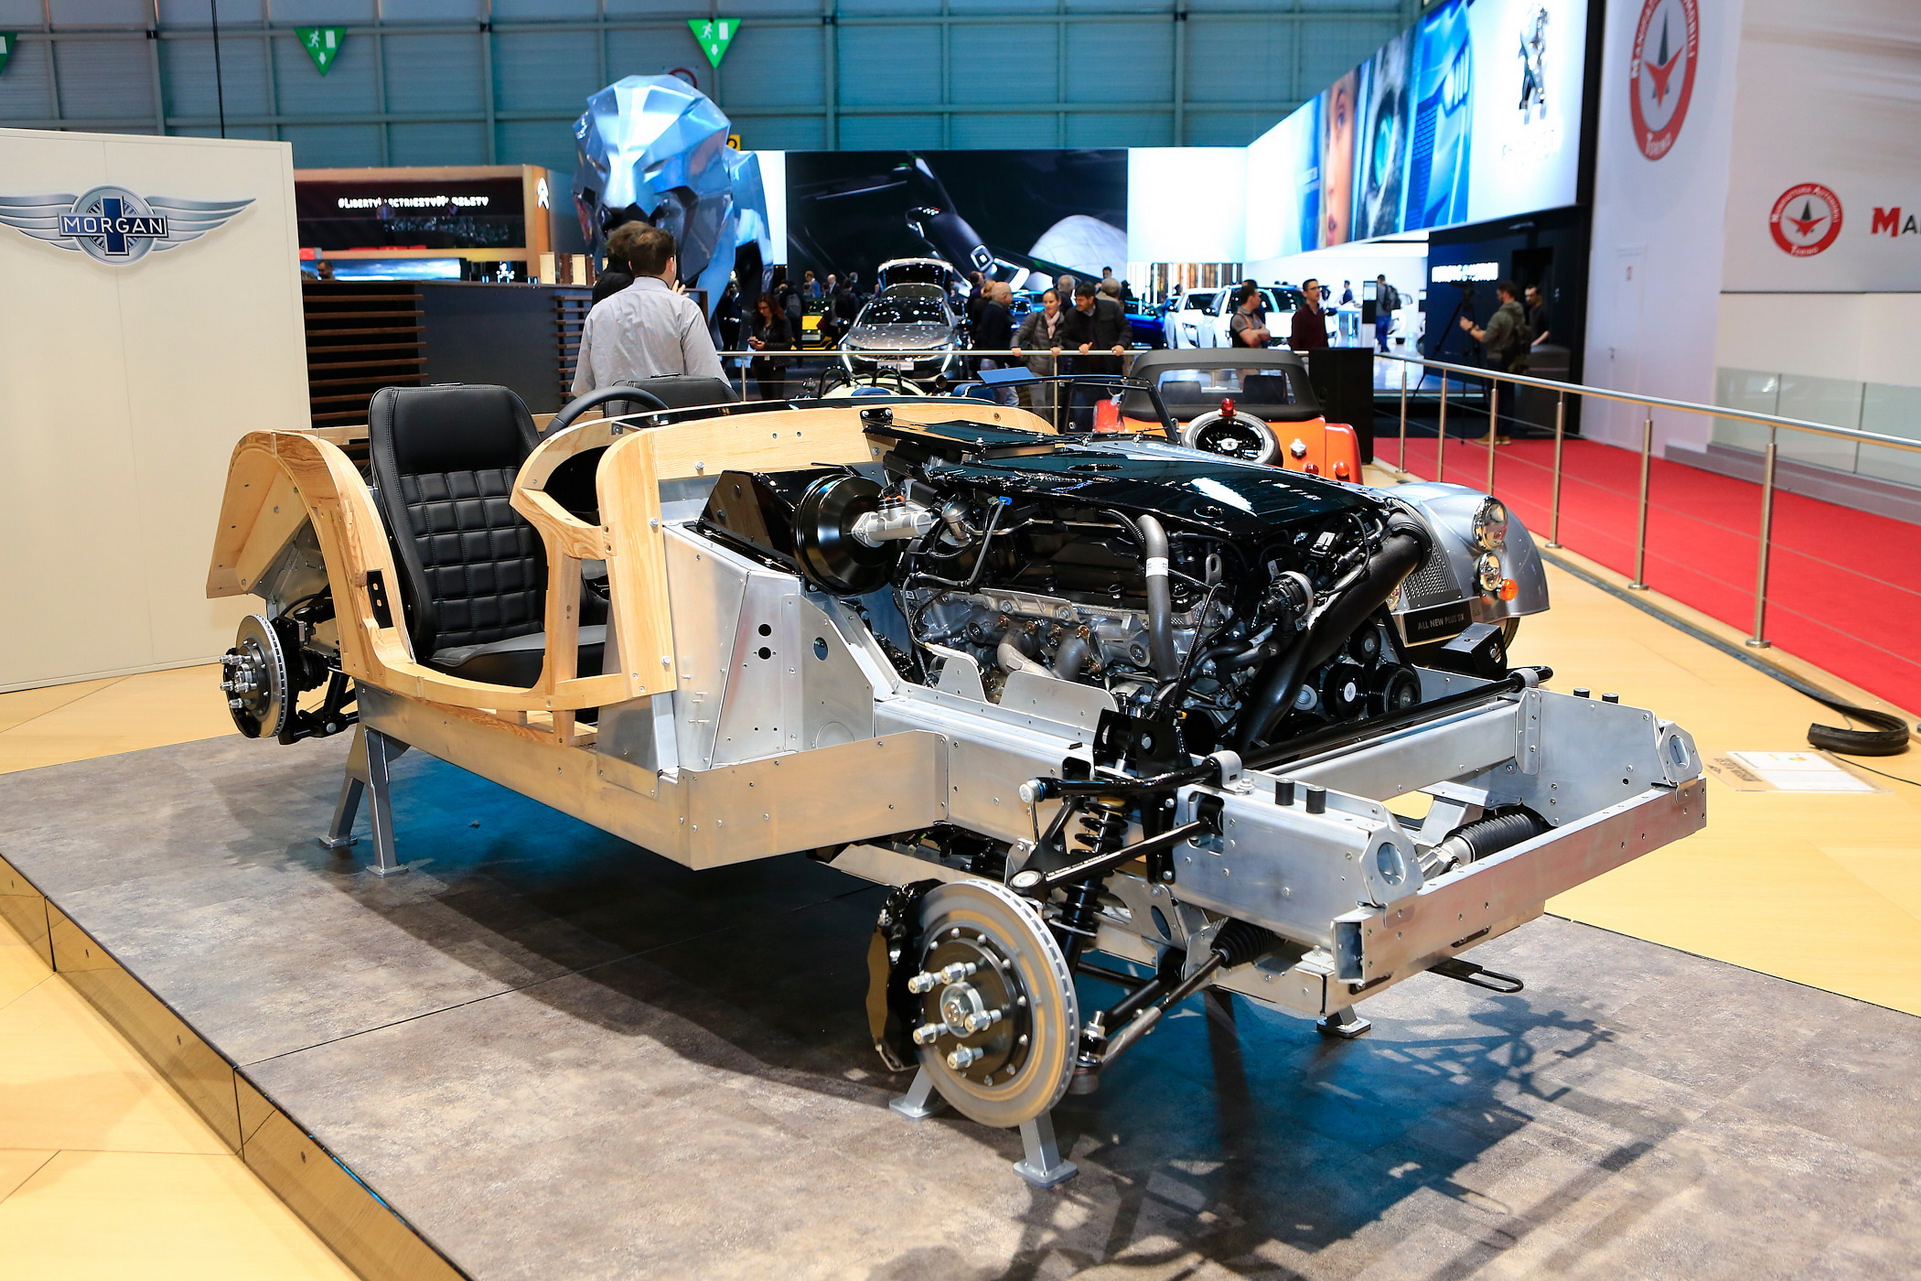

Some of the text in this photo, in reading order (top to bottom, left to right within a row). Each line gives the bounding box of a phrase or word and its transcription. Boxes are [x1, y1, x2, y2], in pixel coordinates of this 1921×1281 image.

[63, 217, 163, 234] MORGAN
[1871, 207, 1921, 238] MA
[1417, 621, 1429, 630] ALL
[1430, 617, 1444, 628] NEW
